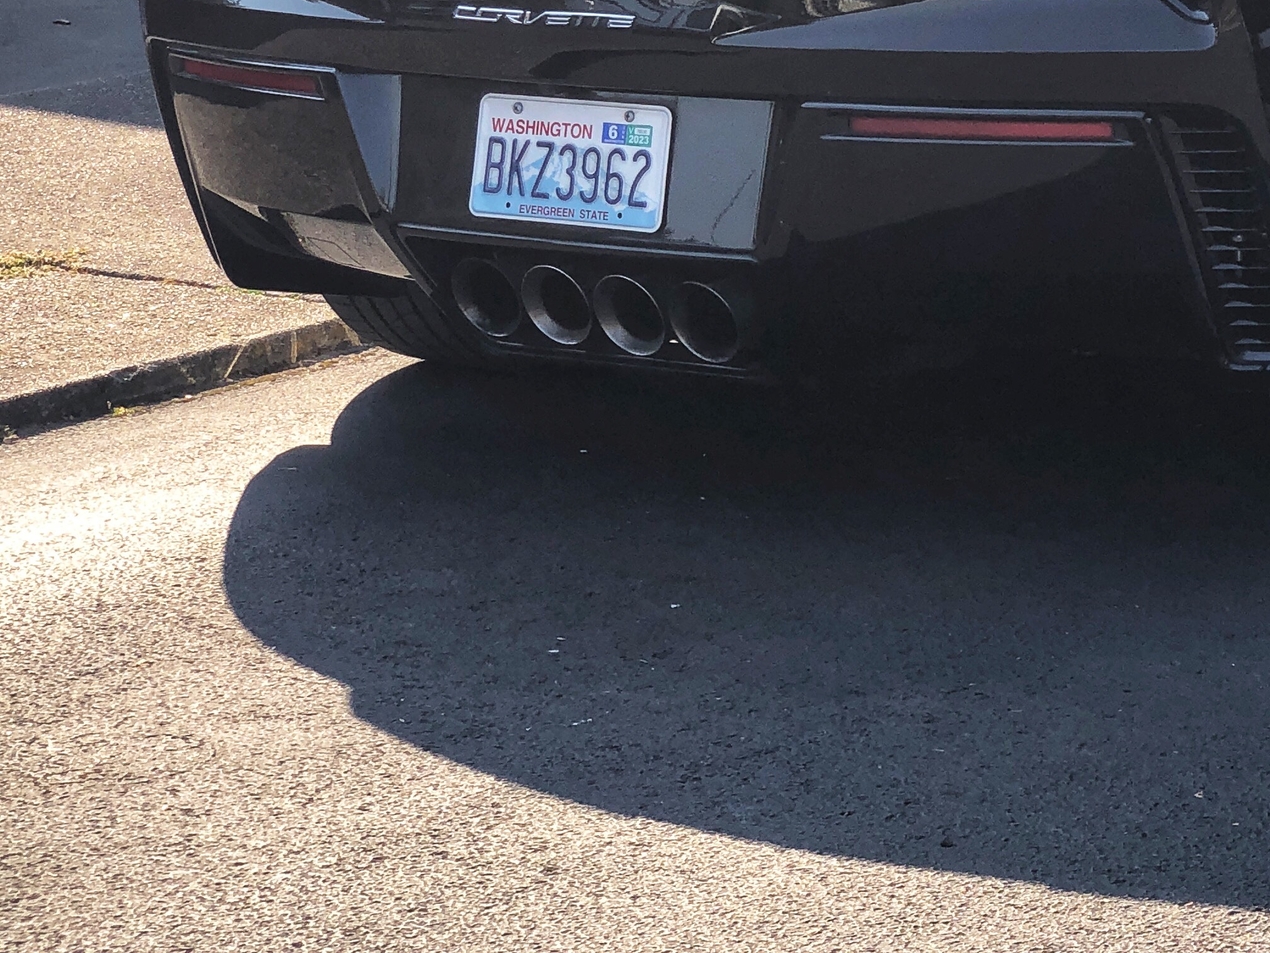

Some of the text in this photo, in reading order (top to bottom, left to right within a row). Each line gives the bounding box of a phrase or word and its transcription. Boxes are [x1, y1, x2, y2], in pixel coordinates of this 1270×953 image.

[453, 5, 636, 28] CORVETTE
[491, 117, 593, 140] WASHINGTON
[608, 124, 618, 140] 6
[628, 134, 650, 145] 2023
[482, 136, 652, 208] BKZ3962
[518, 203, 609, 221] EVERGREEN STATE
